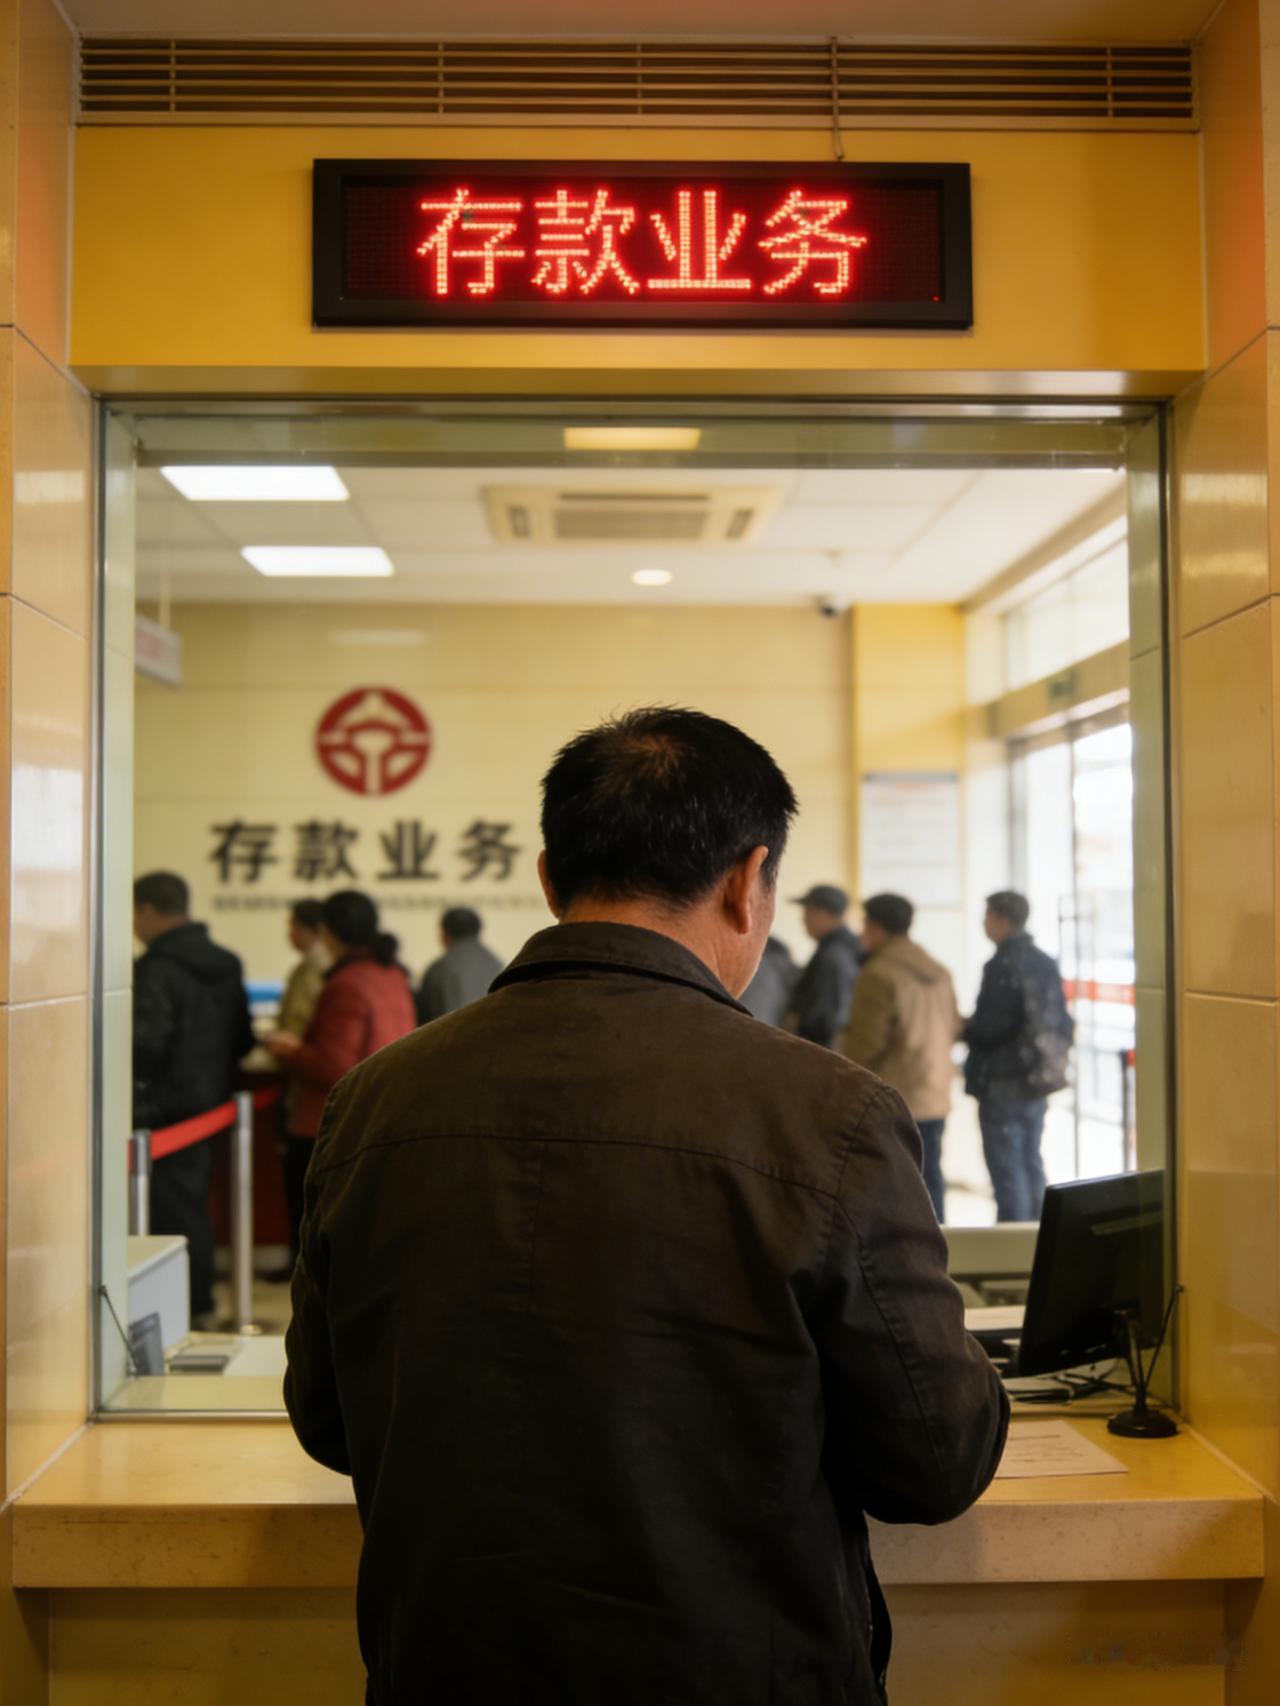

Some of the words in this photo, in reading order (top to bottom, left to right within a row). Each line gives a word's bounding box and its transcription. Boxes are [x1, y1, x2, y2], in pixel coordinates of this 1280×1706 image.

[417, 187, 867, 296] 存款业务
[209, 817, 523, 885] 存款业务
